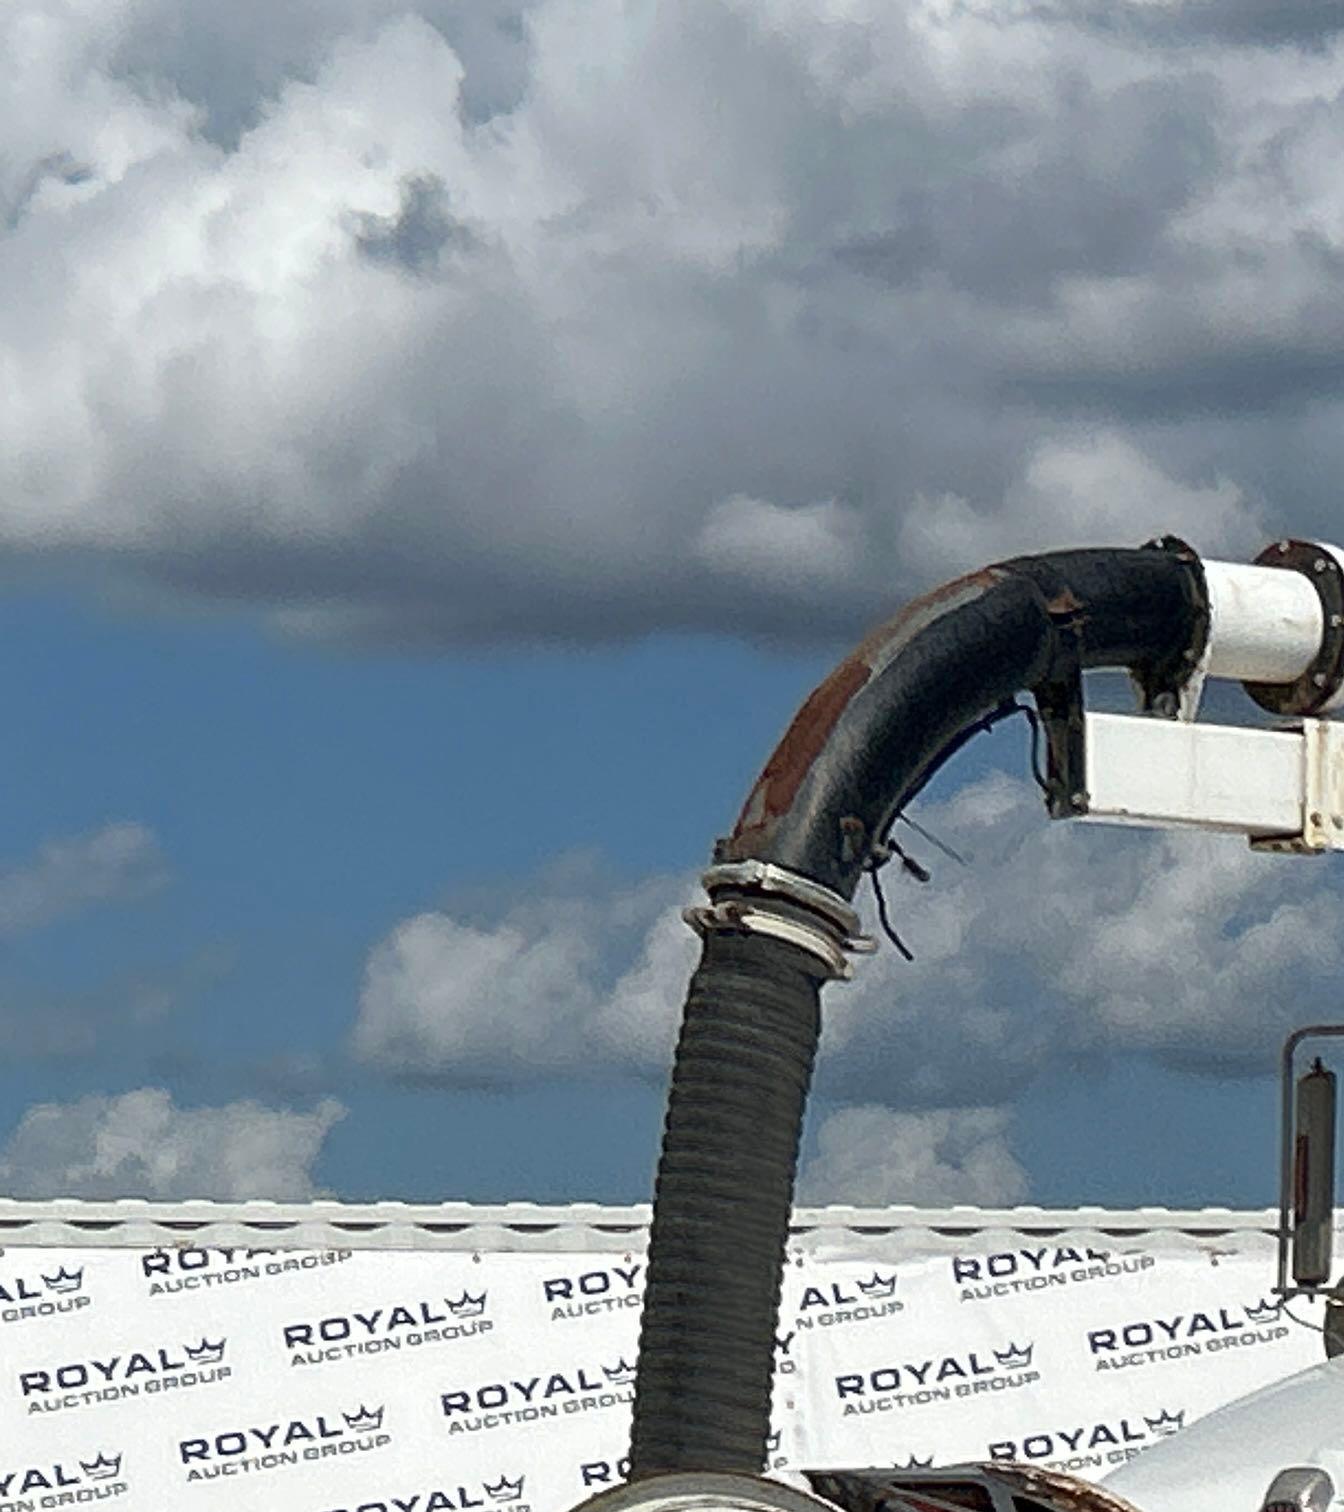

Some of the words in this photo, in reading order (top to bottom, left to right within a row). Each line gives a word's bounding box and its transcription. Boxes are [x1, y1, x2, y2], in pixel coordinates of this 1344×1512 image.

[149, 1266, 260, 1297] AUCTION
[265, 1250, 353, 1276] GROUP
[543, 1264, 642, 1302] ROY
[960, 1271, 1066, 1303] AUCTION
[1070, 1255, 1156, 1281] GROUP
[2, 1296, 91, 1323] GROUP
[283, 1302, 446, 1350] ROYAL
[551, 1292, 641, 1322] AUCTIO
[817, 1300, 905, 1327] GROUP
[1087, 1306, 1244, 1355] ROYAL
[290, 1336, 401, 1368] AUCTION
[406, 1318, 494, 1347] GROUP
[1095, 1344, 1202, 1372] AUCTION
[1207, 1326, 1290, 1353] GROUP
[19, 1348, 185, 1396] ROYAL
[27, 1383, 139, 1415] AUCTION
[144, 1366, 232, 1394] GROUP
[441, 1369, 602, 1417] ROYAL
[835, 1353, 995, 1399] ROYAL
[842, 1387, 951, 1417] AUCTION
[955, 1370, 1042, 1397] GROUP
[448, 1403, 558, 1435] AUCTION
[562, 1390, 635, 1414] GROU
[179, 1416, 343, 1465] ROYAL
[186, 1450, 298, 1482] AUCTION
[303, 1434, 392, 1461] GROUP
[989, 1419, 1145, 1462] ROYAL
[41, 1482, 128, 1509] GROUP
